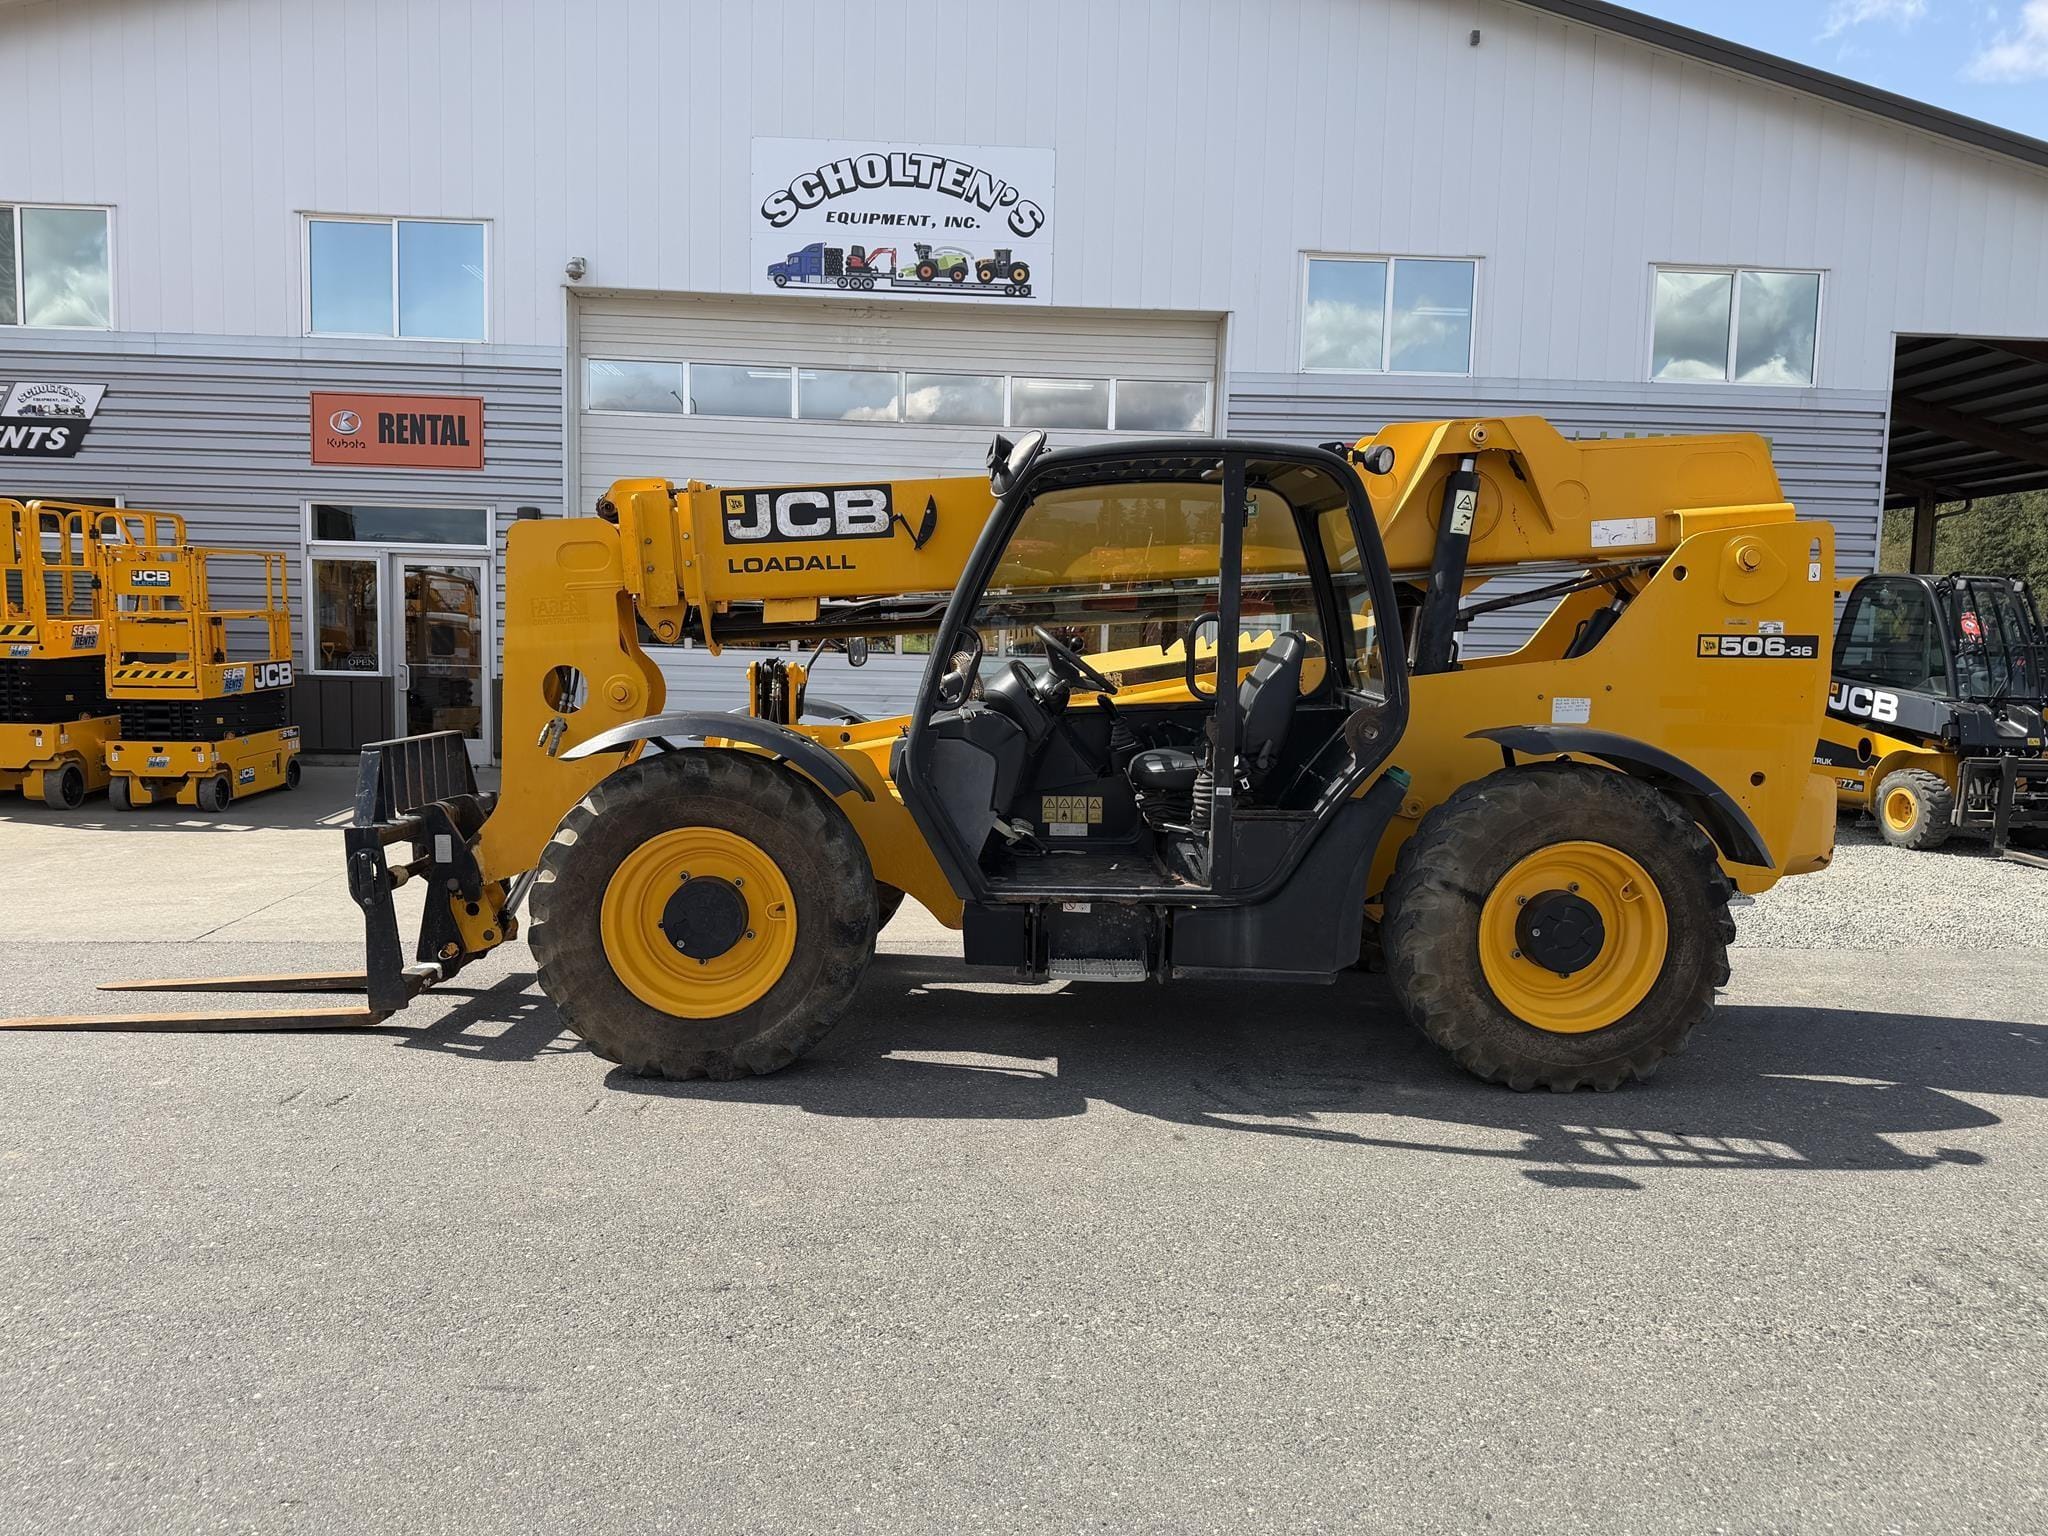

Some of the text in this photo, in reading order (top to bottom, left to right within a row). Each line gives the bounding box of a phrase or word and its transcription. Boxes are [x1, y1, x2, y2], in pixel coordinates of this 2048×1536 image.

[761, 152, 1045, 237] SCHOLTEN'S
[825, 210, 981, 229] EQUIPMENT, INC.
[0, 425, 70, 450] NTS
[378, 412, 470, 447] RENTAL
[326, 437, 366, 449] Kubota
[728, 489, 890, 540] JCB
[728, 555, 856, 574] LOADALL
[132, 570, 170, 582] JCB
[74, 635, 96, 646] RENTS
[1720, 636, 1813, 656] 506-36
[348, 658, 375, 666] OPEN
[254, 662, 292, 689] JCB
[1828, 684, 1899, 723] JCB
[239, 767, 255, 780] JCB
